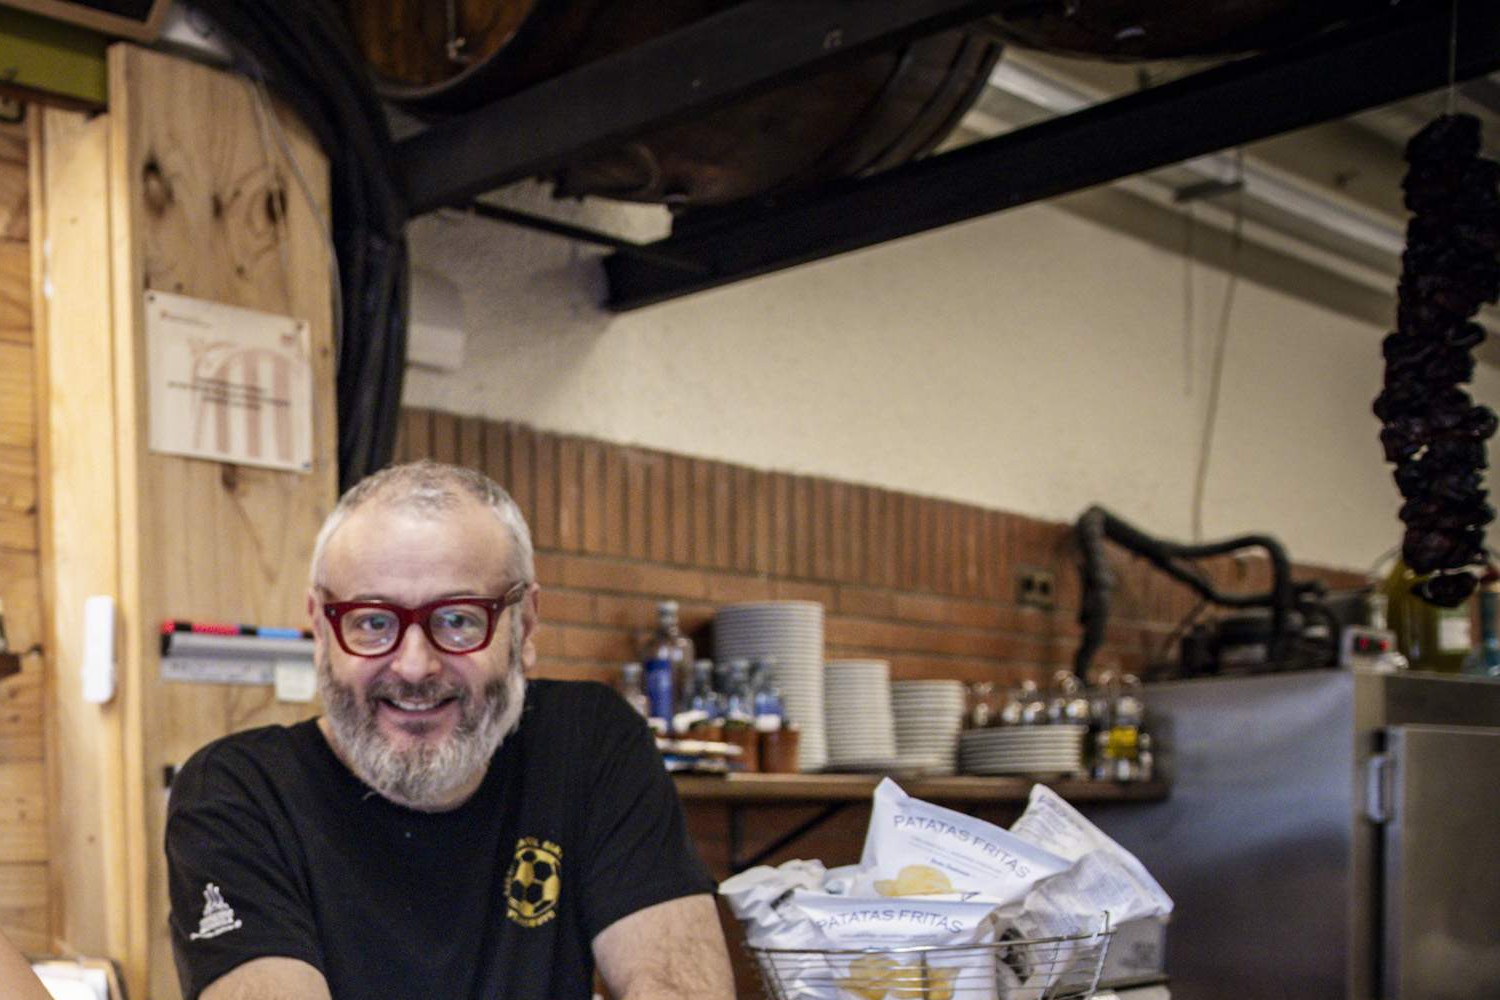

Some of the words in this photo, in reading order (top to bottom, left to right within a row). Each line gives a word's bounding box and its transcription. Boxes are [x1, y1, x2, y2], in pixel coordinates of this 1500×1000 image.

[893, 815, 970, 842] PATATAS
[972, 834, 1030, 878] FRITAS
[817, 909, 894, 929] PATATAS
[899, 909, 964, 934] FRITAS
